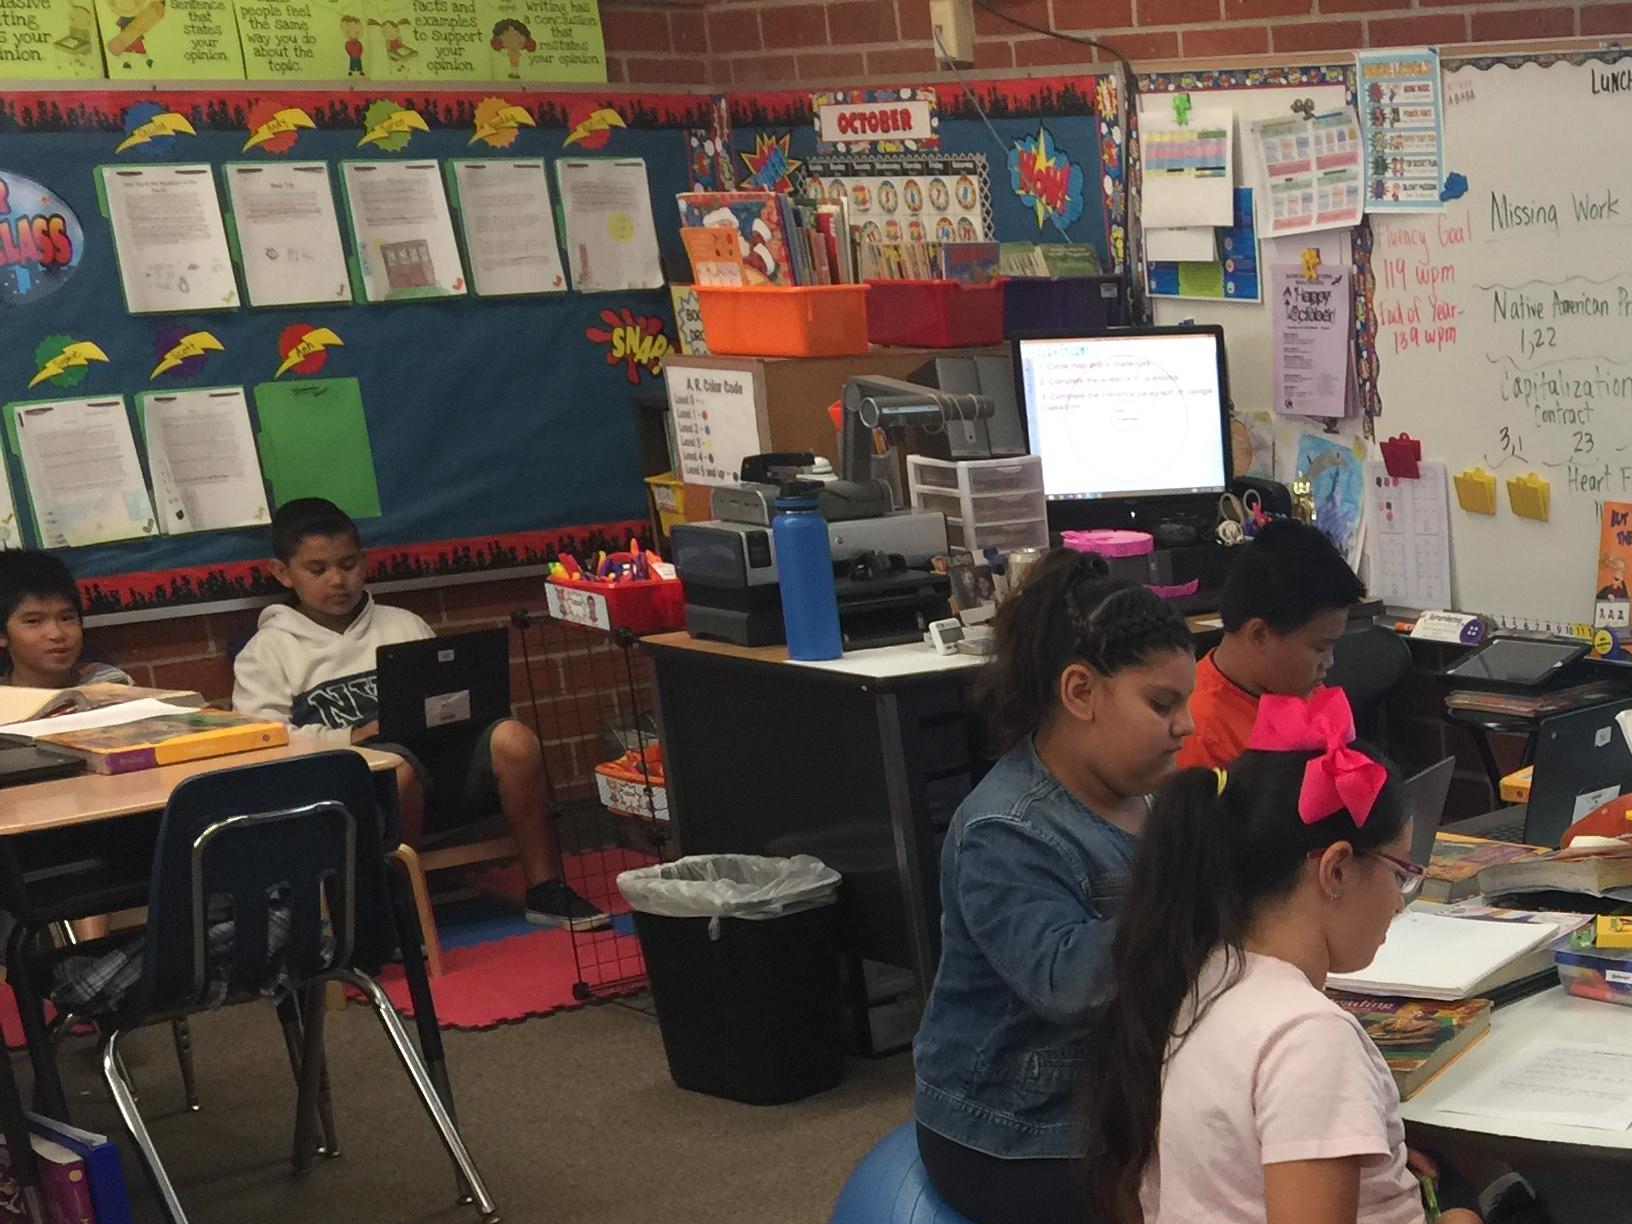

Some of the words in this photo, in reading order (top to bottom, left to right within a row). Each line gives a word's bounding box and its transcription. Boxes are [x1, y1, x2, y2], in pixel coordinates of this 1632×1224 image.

[188, 12, 212, 22] that
[14, 34, 51, 47] your
[275, 35, 298, 46] you
[837, 108, 913, 135] OCTOBER
[1490, 190, 1558, 233] Missing
[1571, 189, 1621, 224] Work
[1376, 222, 1428, 264] Fluency
[1437, 214, 1472, 248] Goal
[1493, 290, 1545, 322] Native
[1552, 289, 1610, 319] American
[1425, 324, 1457, 352] wpm
[1534, 405, 1595, 428] Contract
[1567, 463, 1613, 493] Heart
